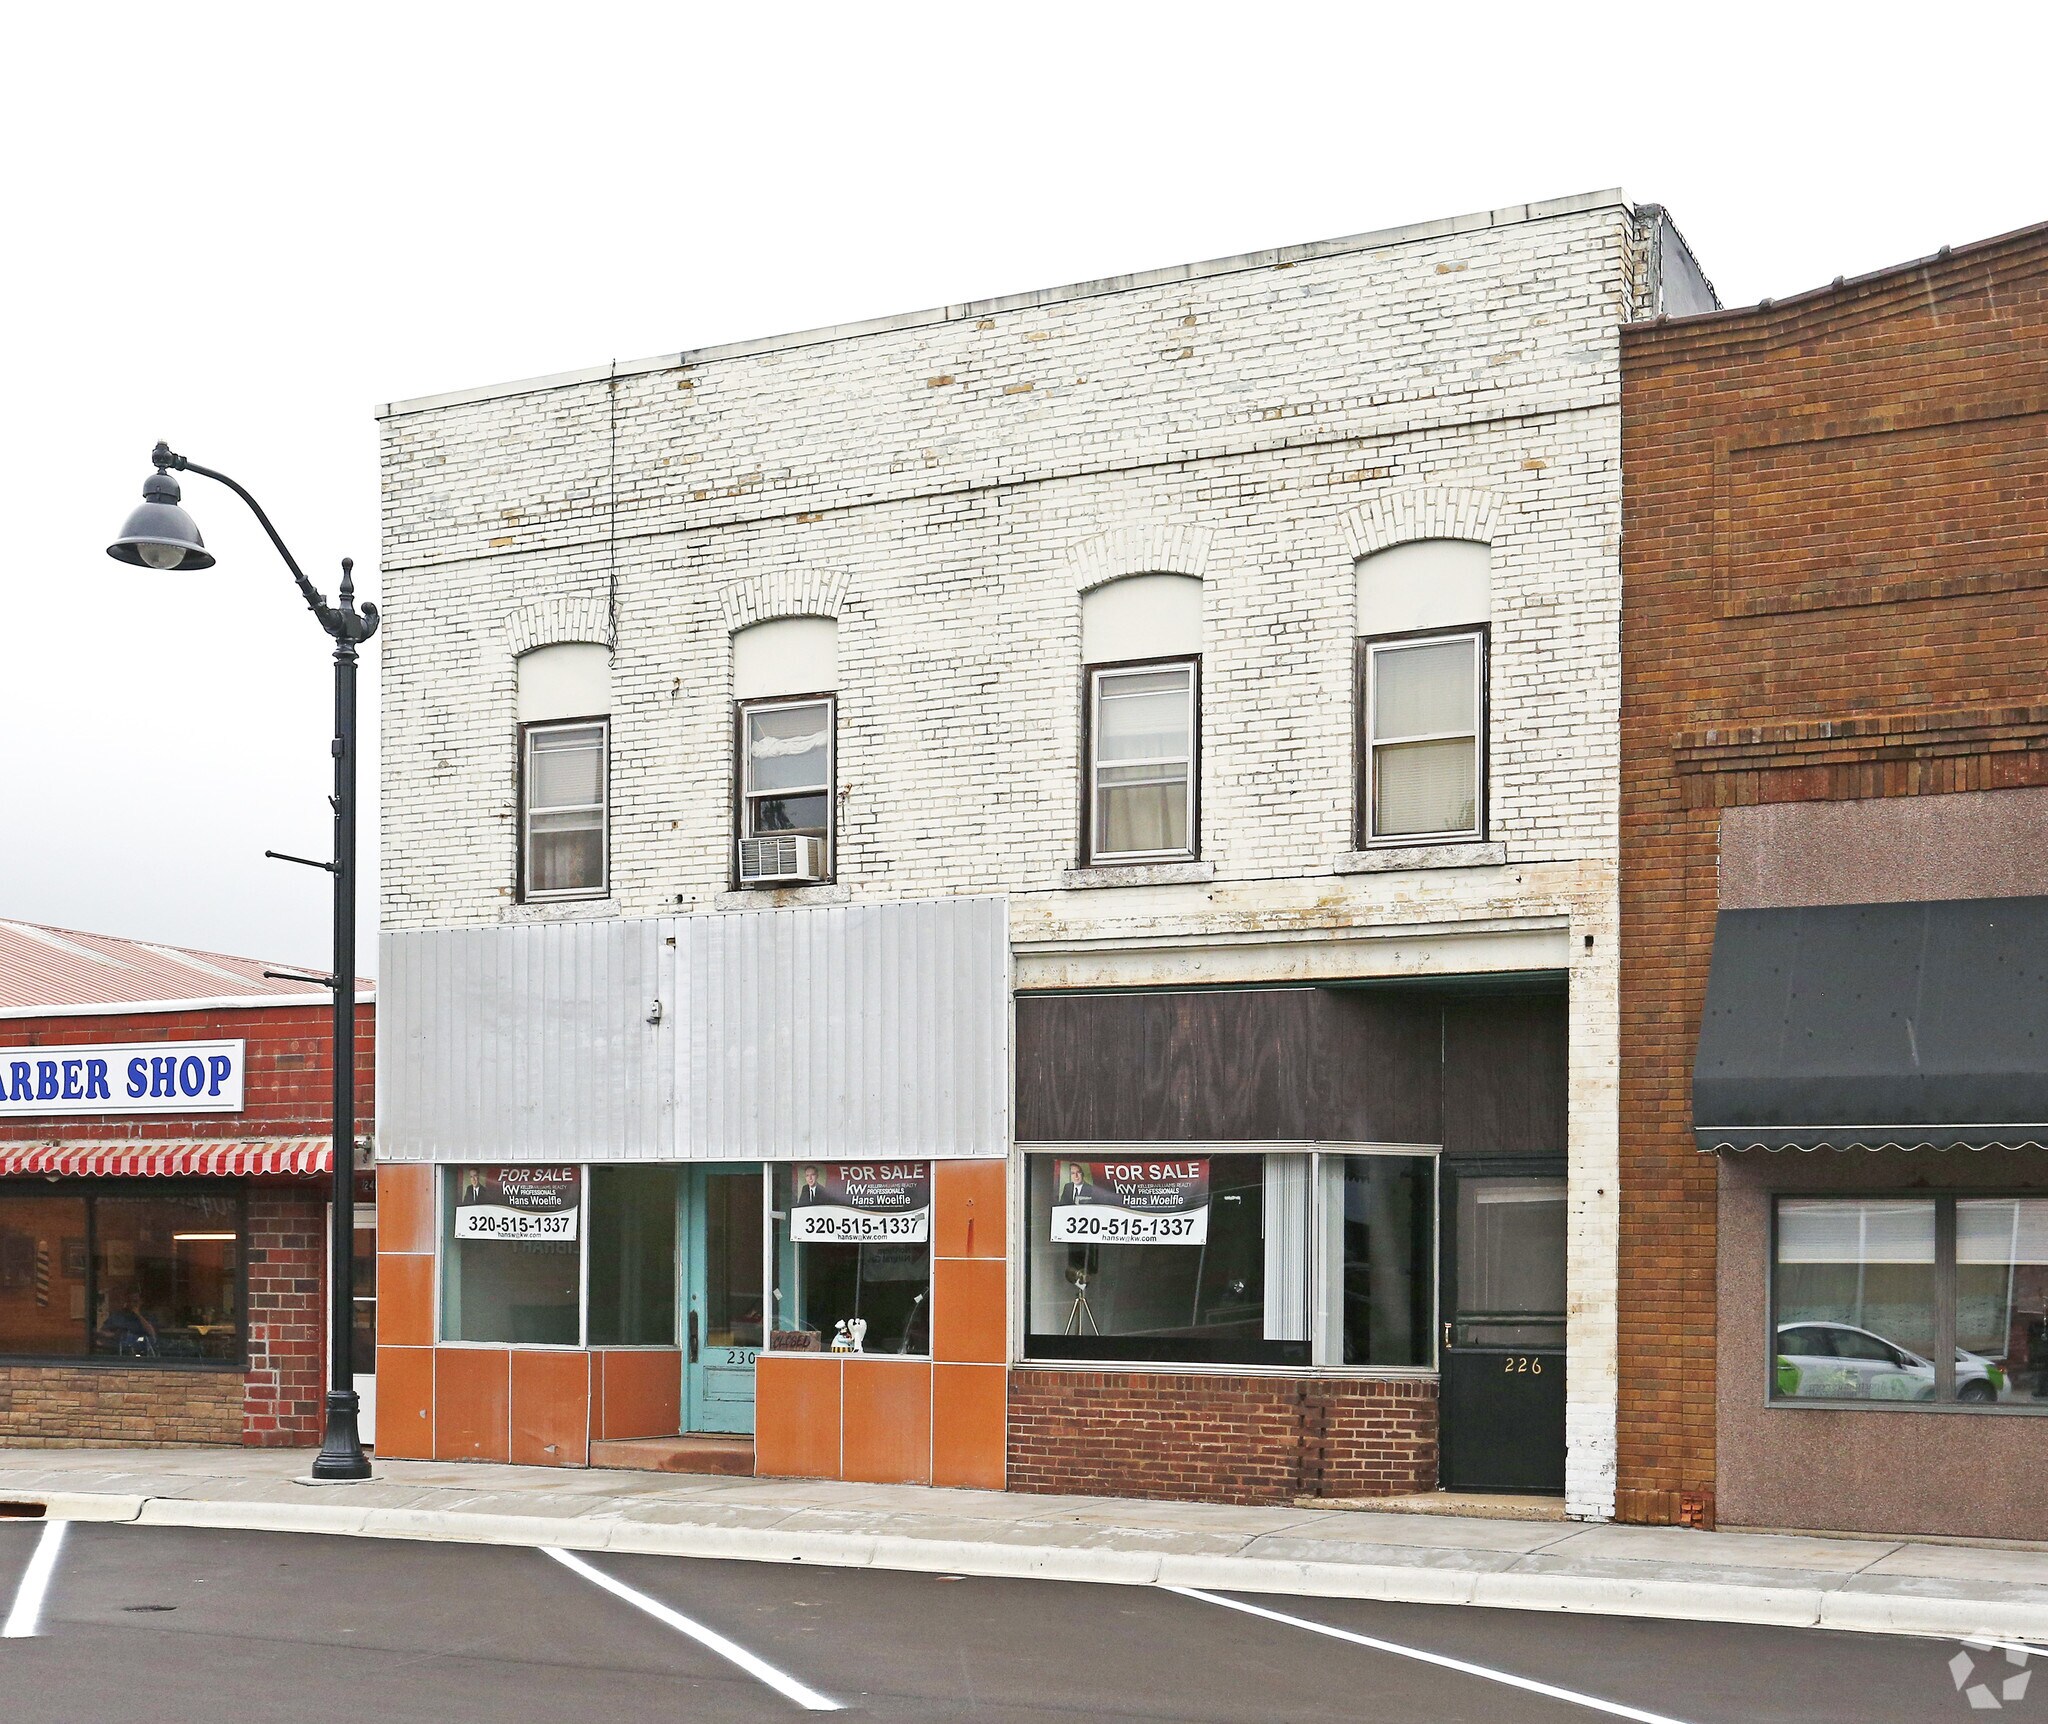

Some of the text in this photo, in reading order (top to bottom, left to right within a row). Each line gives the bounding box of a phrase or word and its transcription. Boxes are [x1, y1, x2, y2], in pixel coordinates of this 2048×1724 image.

[0, 1055, 232, 1101] RBER SHOP
[498, 1167, 573, 1181] FOR SALE
[839, 1163, 924, 1180] FOR SALE
[1104, 1162, 1200, 1180] FOR SALE
[866, 1187, 905, 1195] PROFESSIONALS
[1137, 1187, 1180, 1195] PROFESSIONALS
[509, 1195, 562, 1205] Hans Woelfle
[851, 1194, 911, 1205] Hans Woelfle
[1122, 1194, 1184, 1205] Hans Woelfle
[468, 1216, 570, 1233] 320-515-1337
[805, 1217, 919, 1234] 320-515-1337
[1066, 1217, 1195, 1236] 320-515-1337
[773, 1335, 811, 1348] CLOSED
[727, 1350, 755, 1364] 230
[1505, 1357, 1541, 1374] 226
